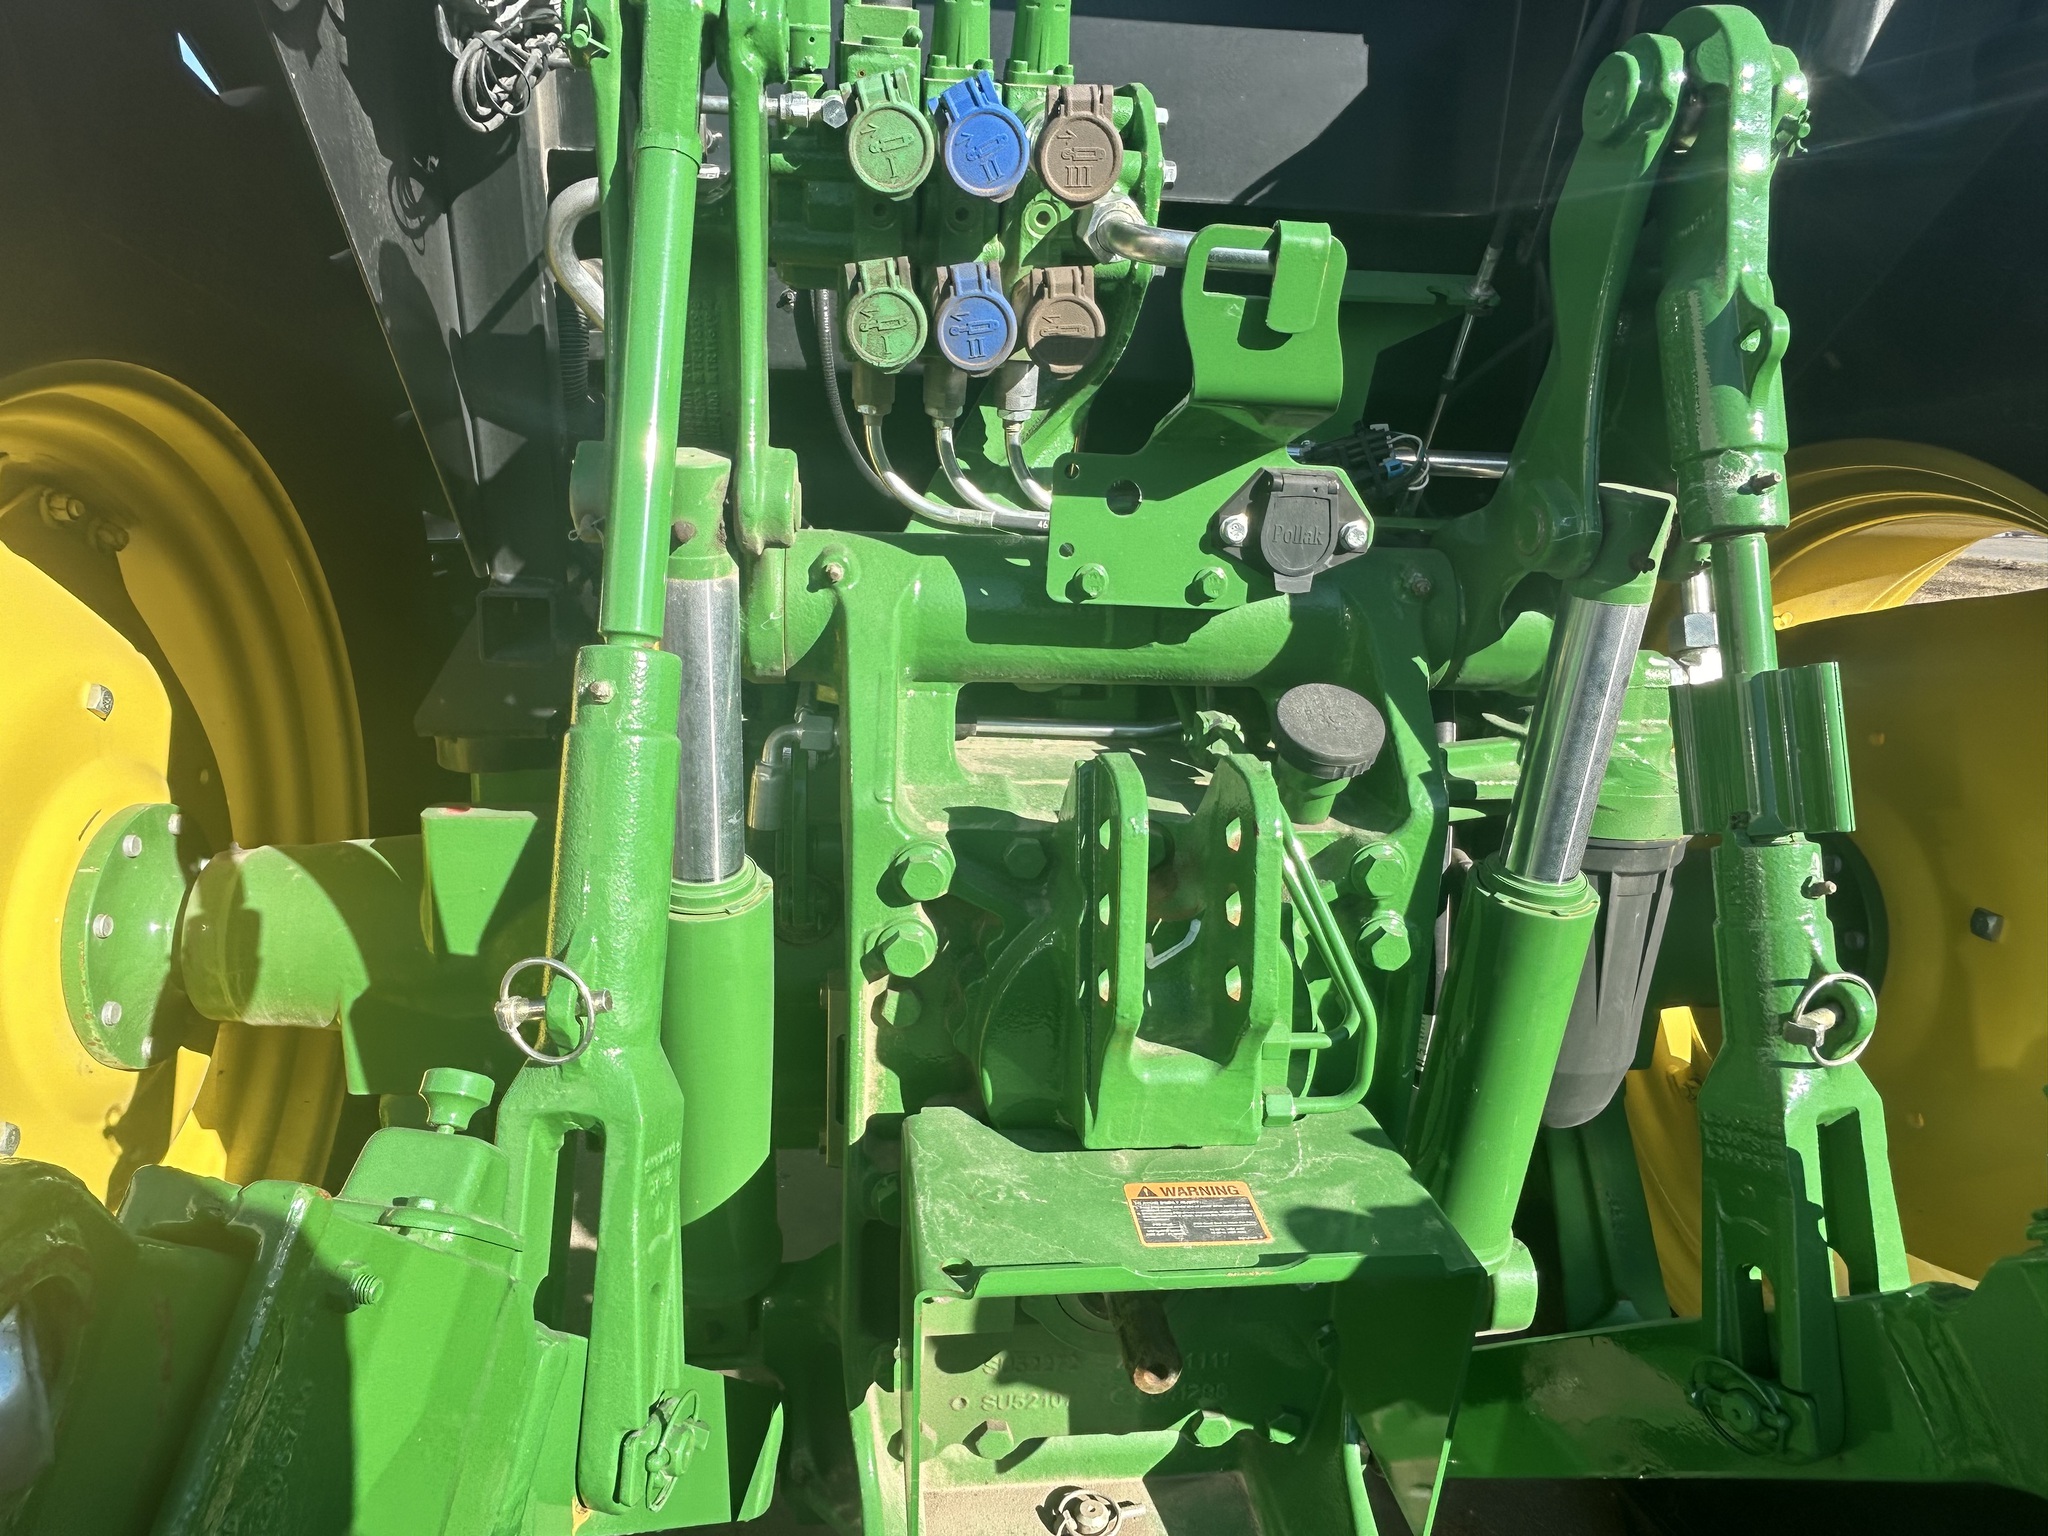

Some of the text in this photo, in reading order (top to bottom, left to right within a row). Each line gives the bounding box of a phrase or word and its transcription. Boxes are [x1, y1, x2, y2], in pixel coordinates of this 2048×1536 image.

[1064, 164, 1094, 189] III
[1271, 523, 1324, 546] Pollak
[1159, 1185, 1240, 1197] WARNING
